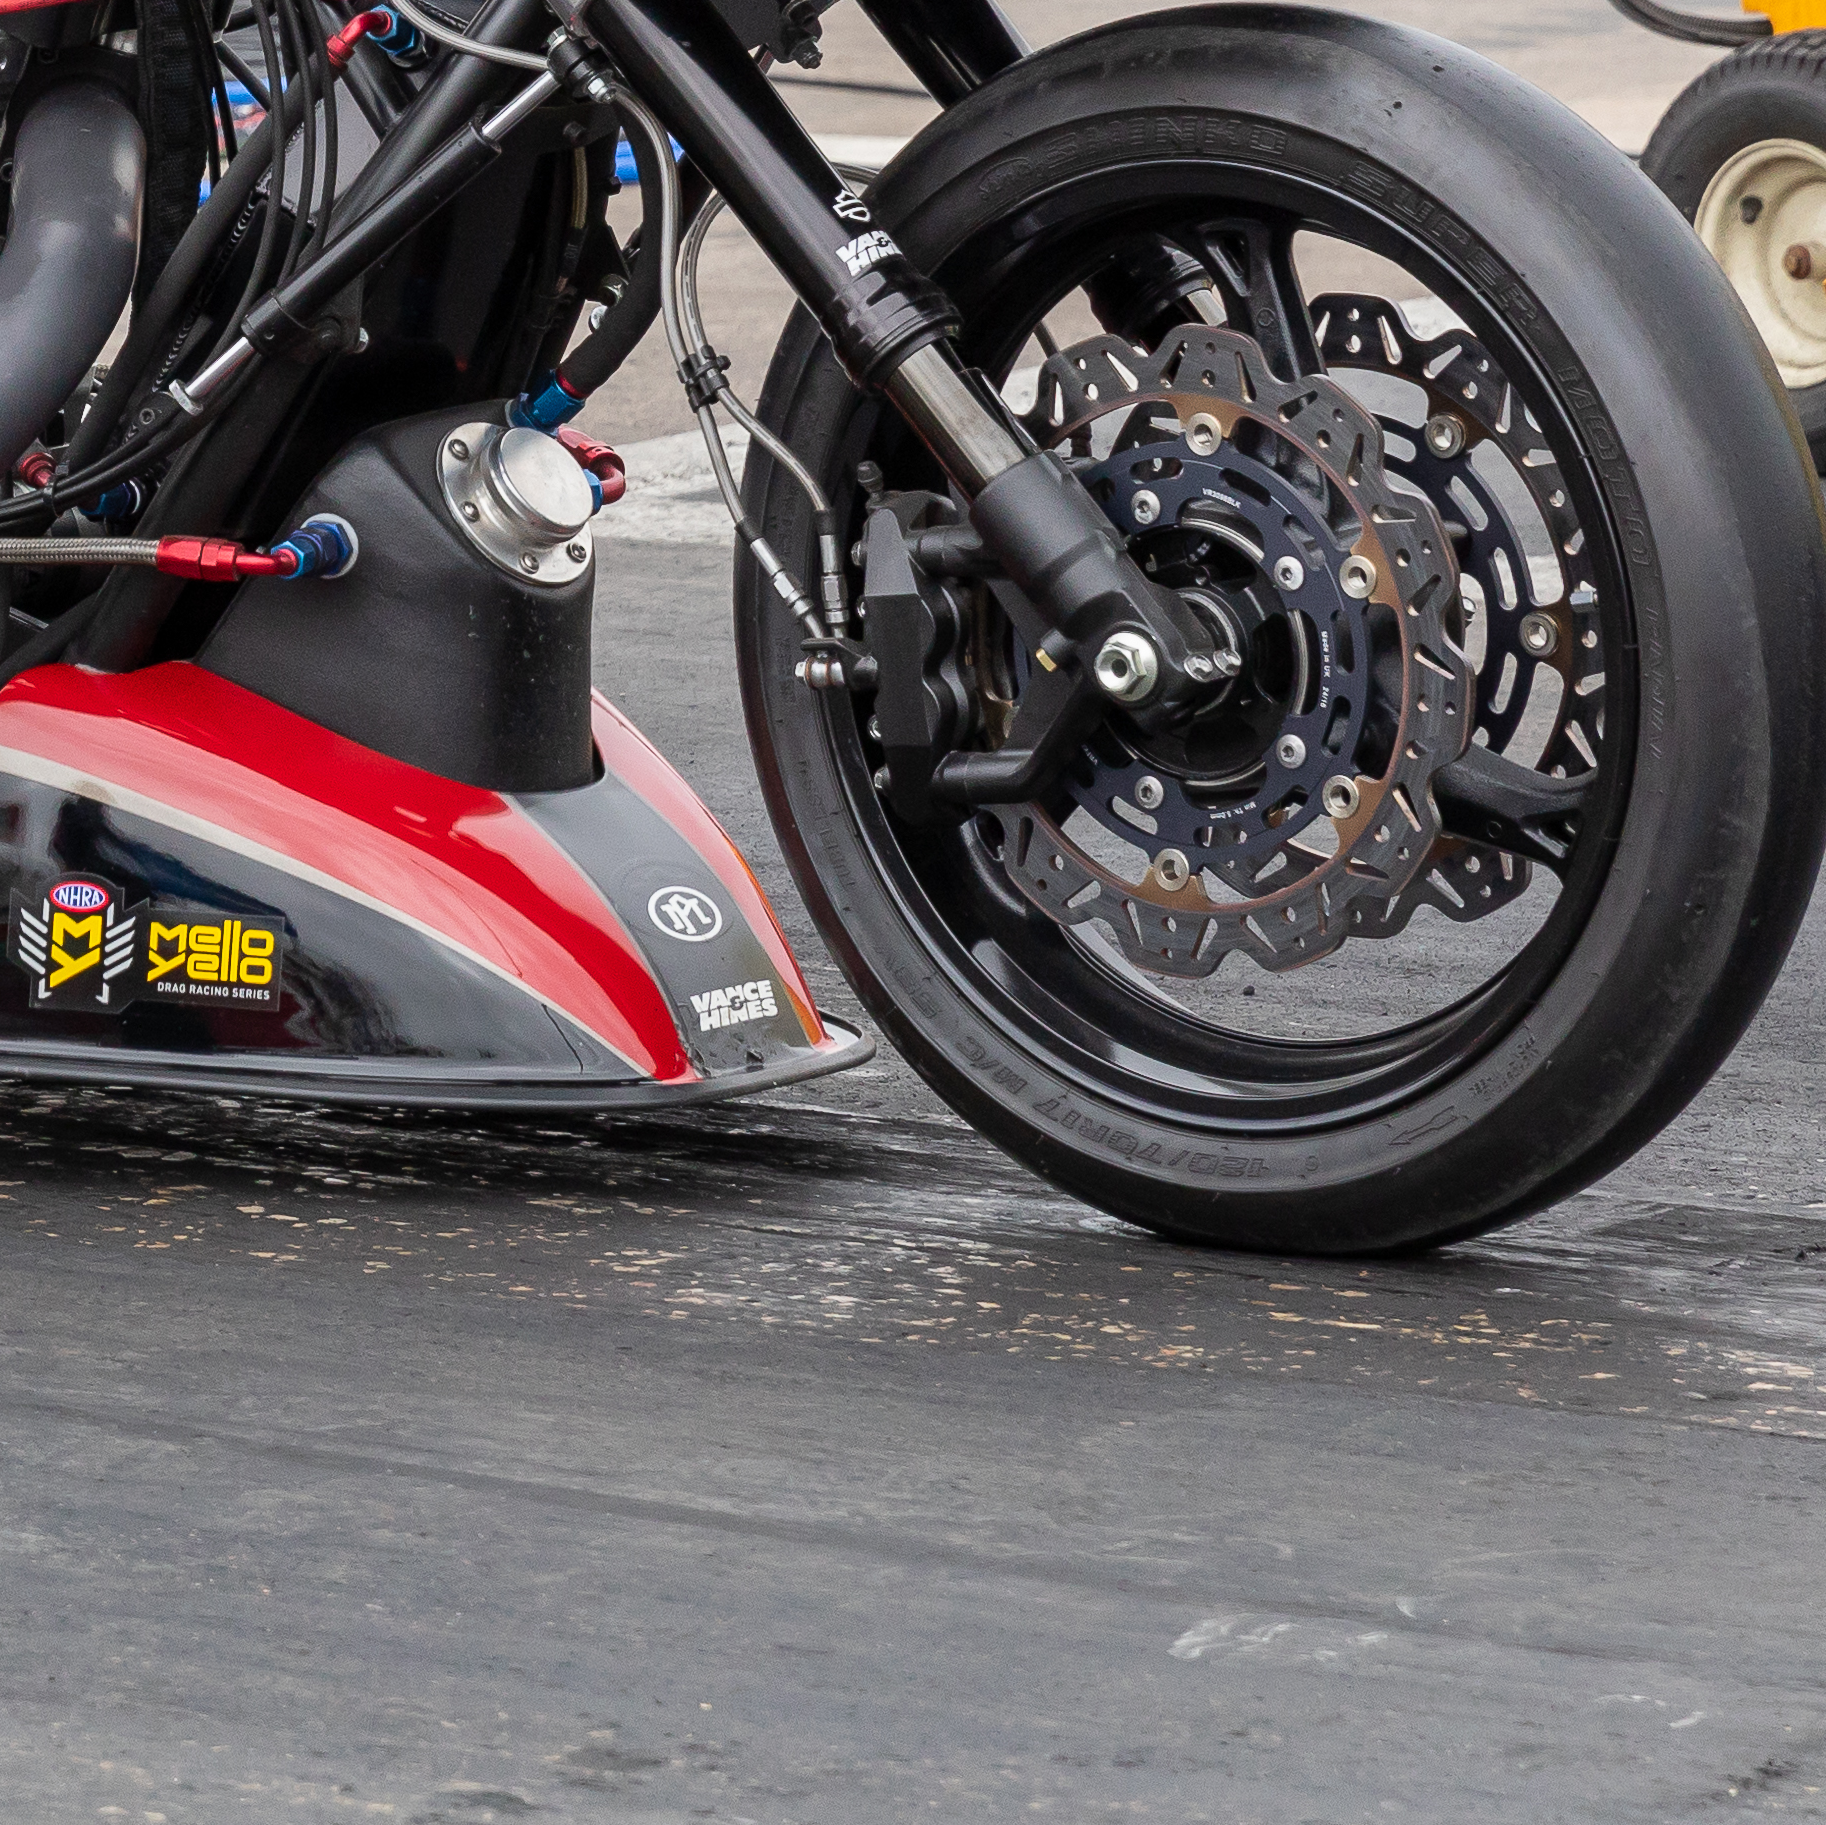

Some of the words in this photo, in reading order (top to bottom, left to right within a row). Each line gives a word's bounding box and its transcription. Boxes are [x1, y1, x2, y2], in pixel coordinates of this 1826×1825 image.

[1323, 664, 1331, 679] UK
[58, 886, 101, 908] NHRA
[157, 981, 186, 994] DRAG
[189, 983, 229, 998] RACING
[232, 987, 270, 1001] SERIES
[689, 979, 775, 1014] VANCE
[698, 997, 779, 1032] HINES
